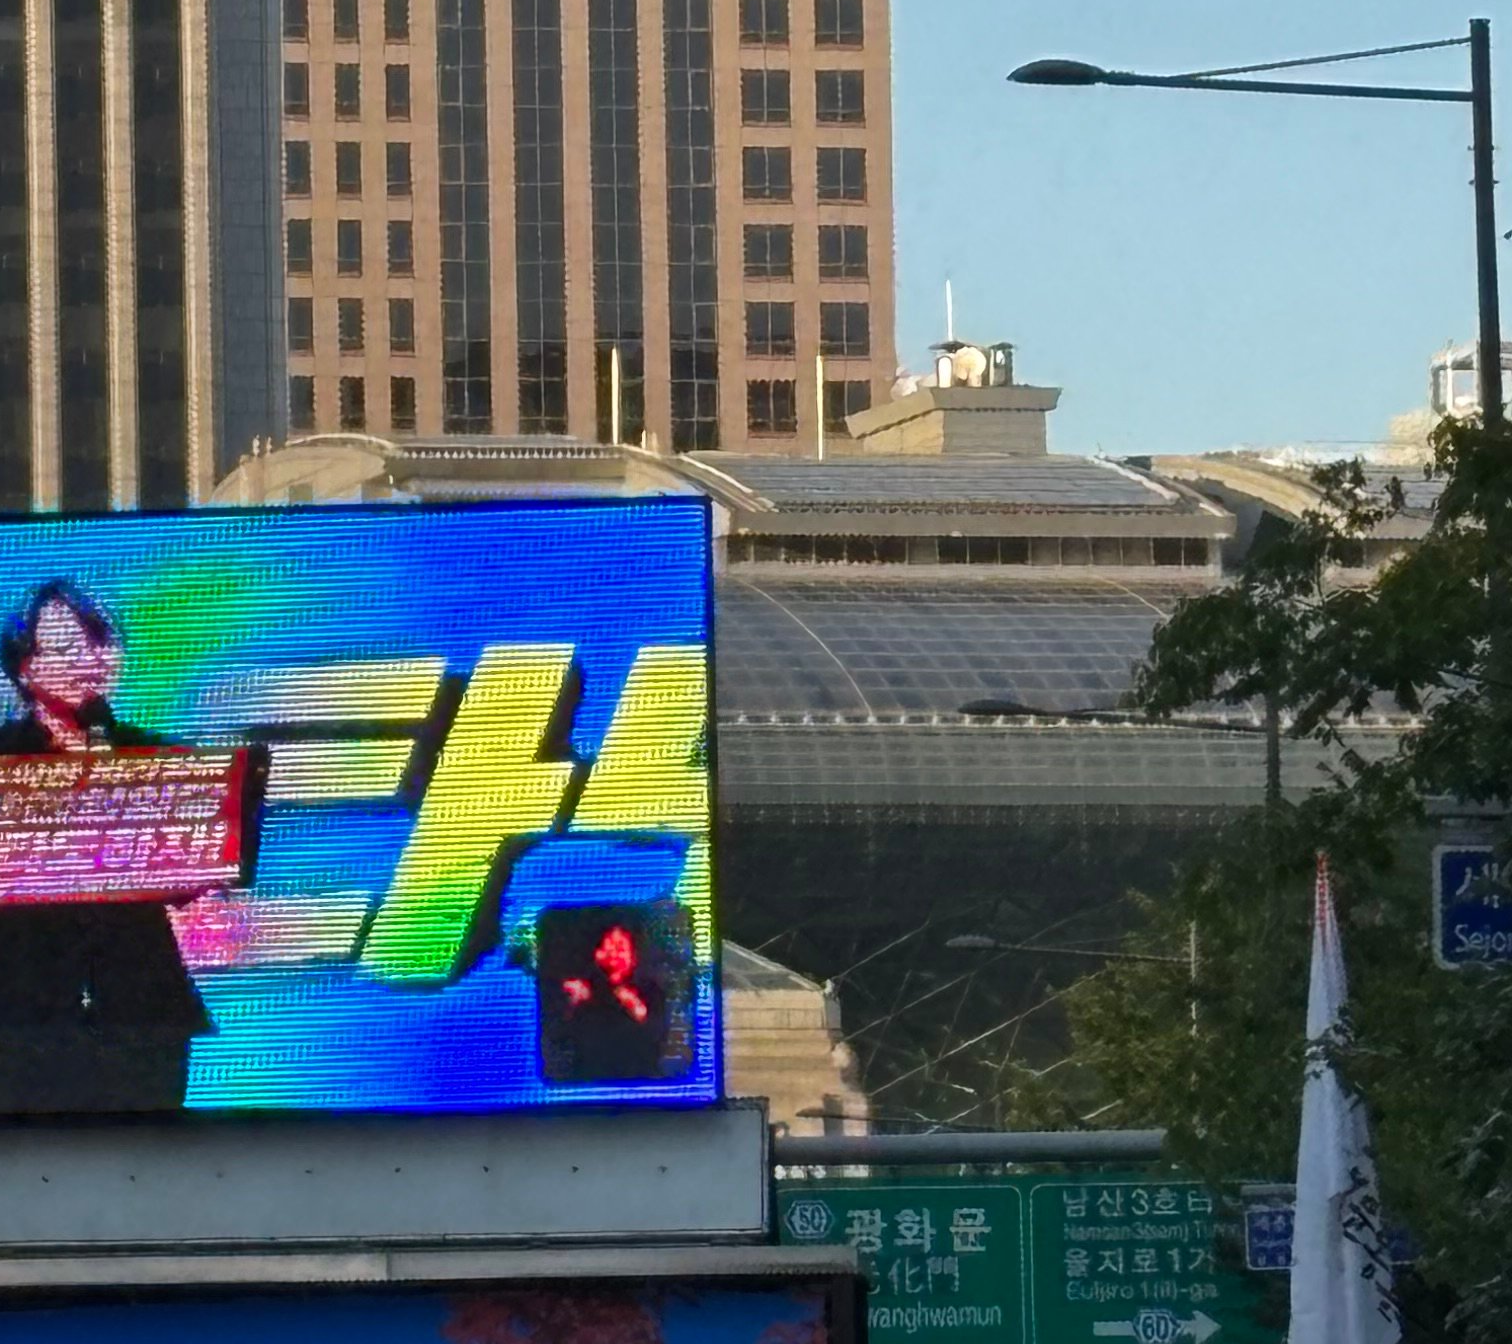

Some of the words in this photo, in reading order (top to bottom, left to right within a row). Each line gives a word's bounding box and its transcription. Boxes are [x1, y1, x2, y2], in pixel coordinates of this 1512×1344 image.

[1455, 923, 1512, 958] Sejo
[845, 1208, 992, 1253] 광화문
[868, 1302, 1001, 1334] wanghwamun
